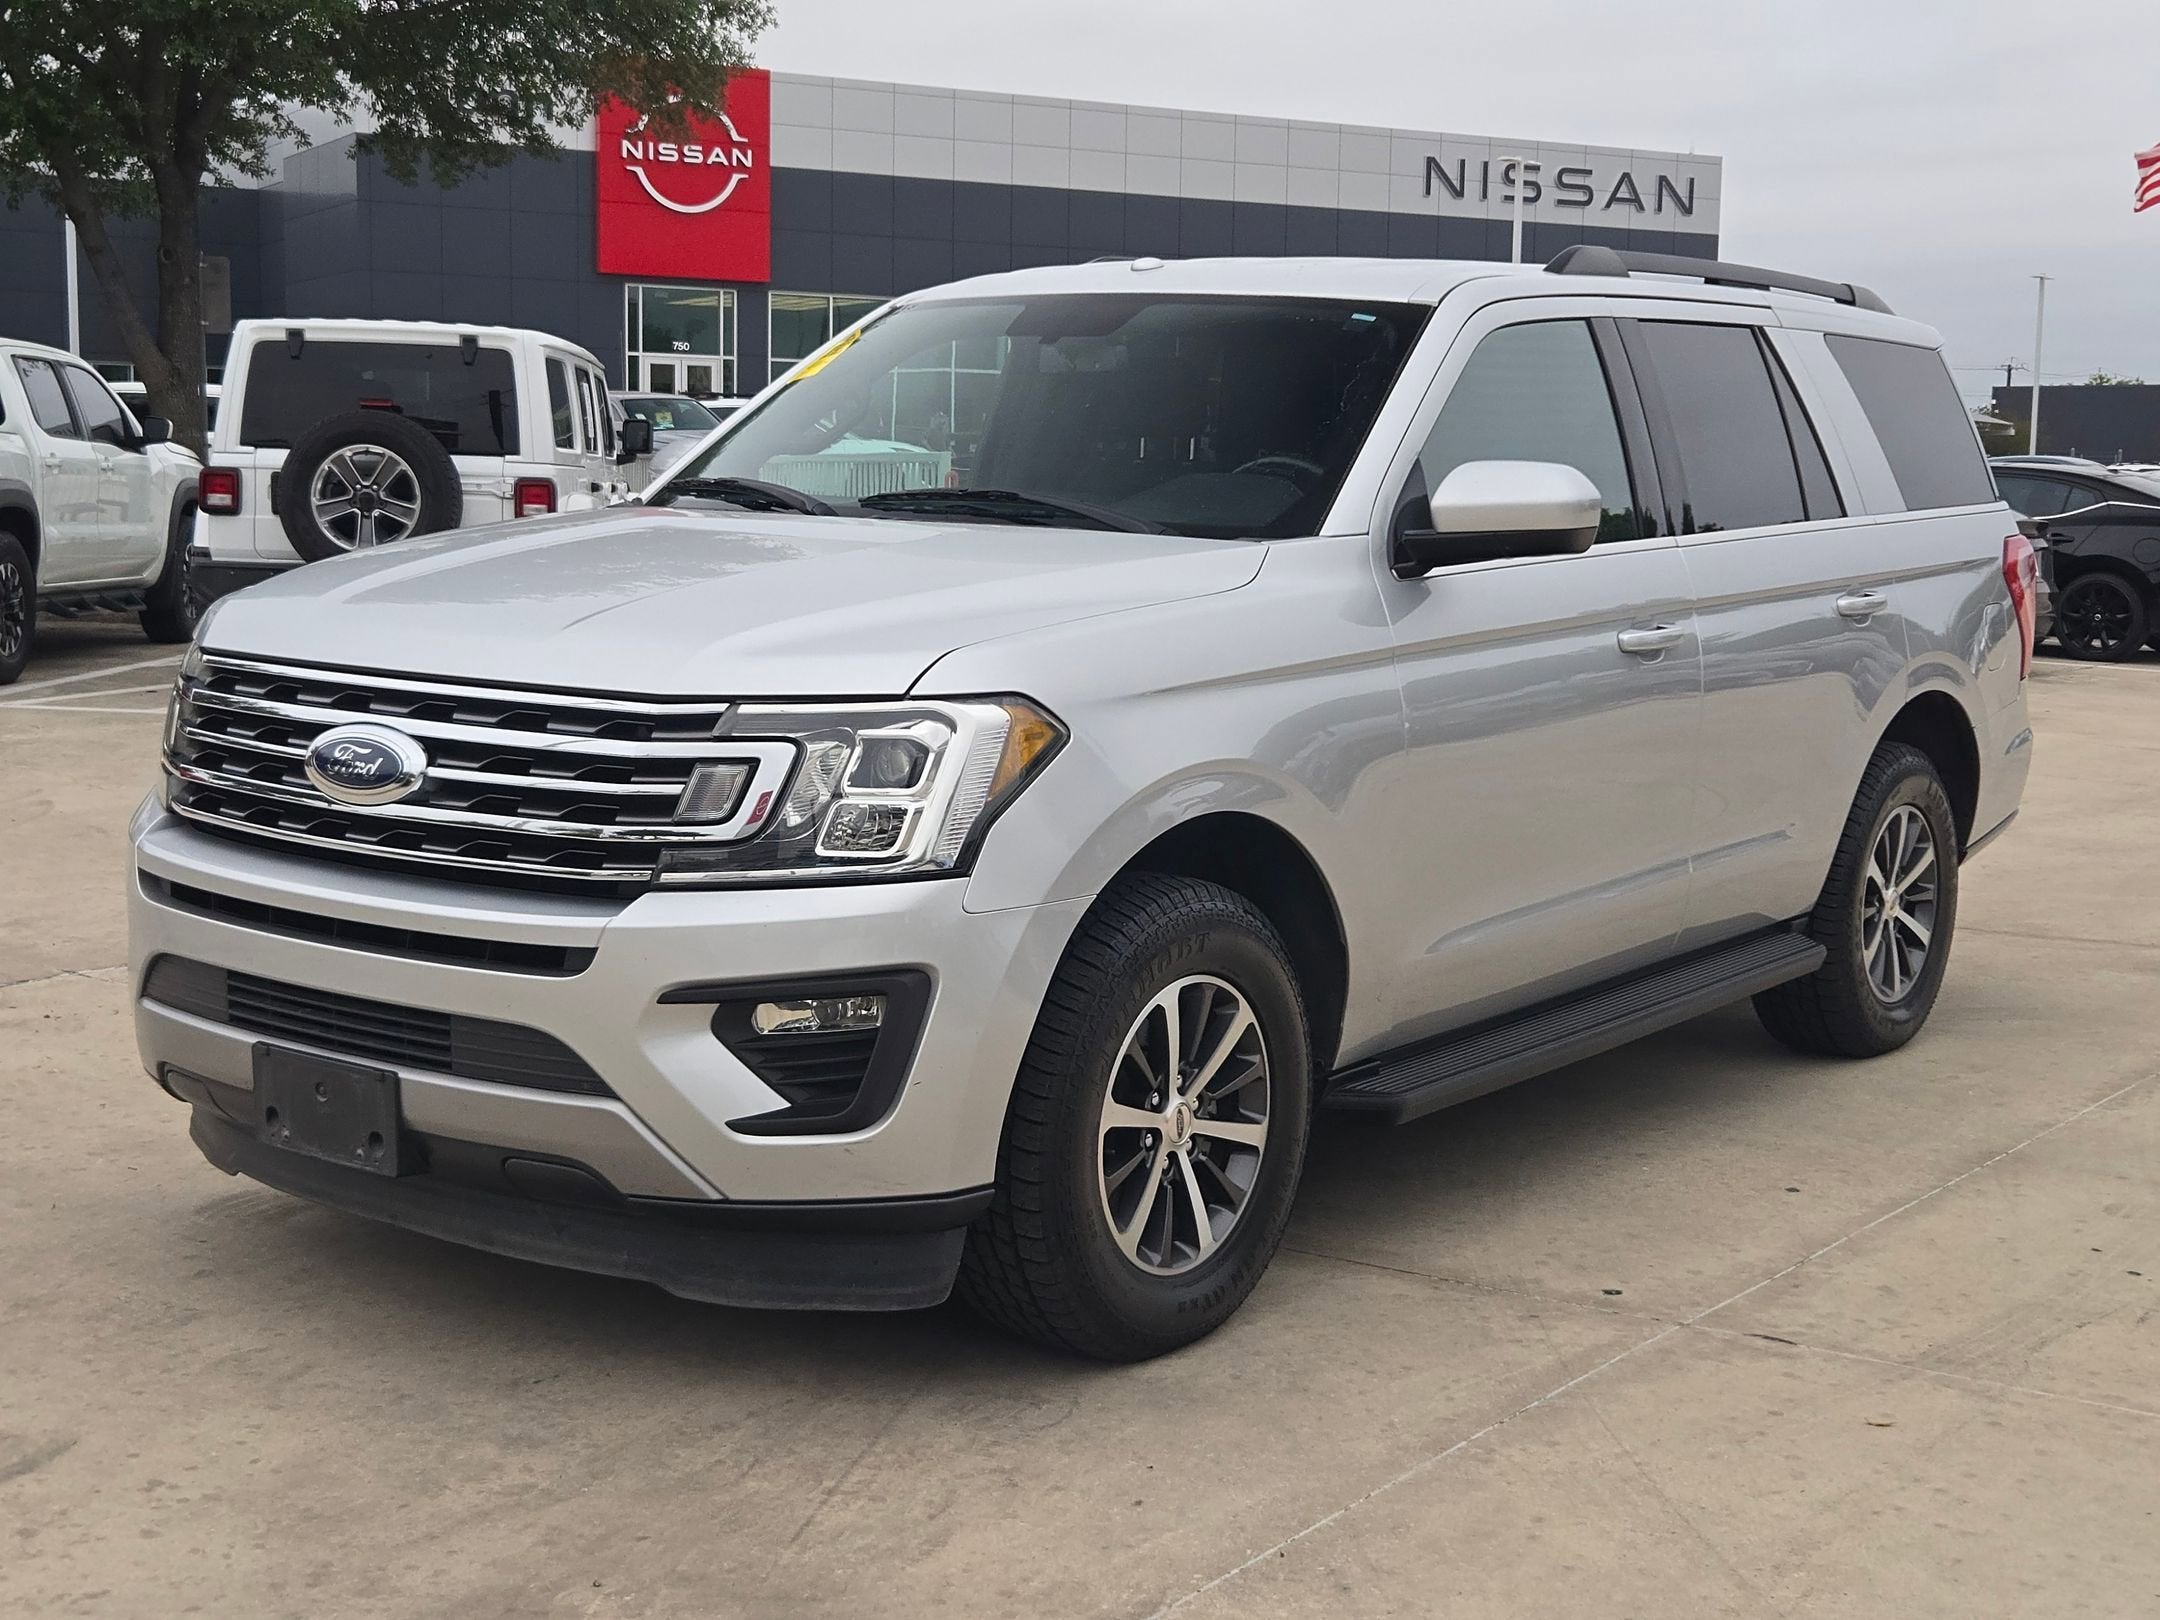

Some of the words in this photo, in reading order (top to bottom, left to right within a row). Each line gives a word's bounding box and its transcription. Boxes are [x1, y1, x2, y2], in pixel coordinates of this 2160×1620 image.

[621, 139, 753, 168] NISSAN
[1423, 155, 1696, 217] NISSAN
[672, 341, 690, 351] 750
[327, 743, 384, 779] Ford
